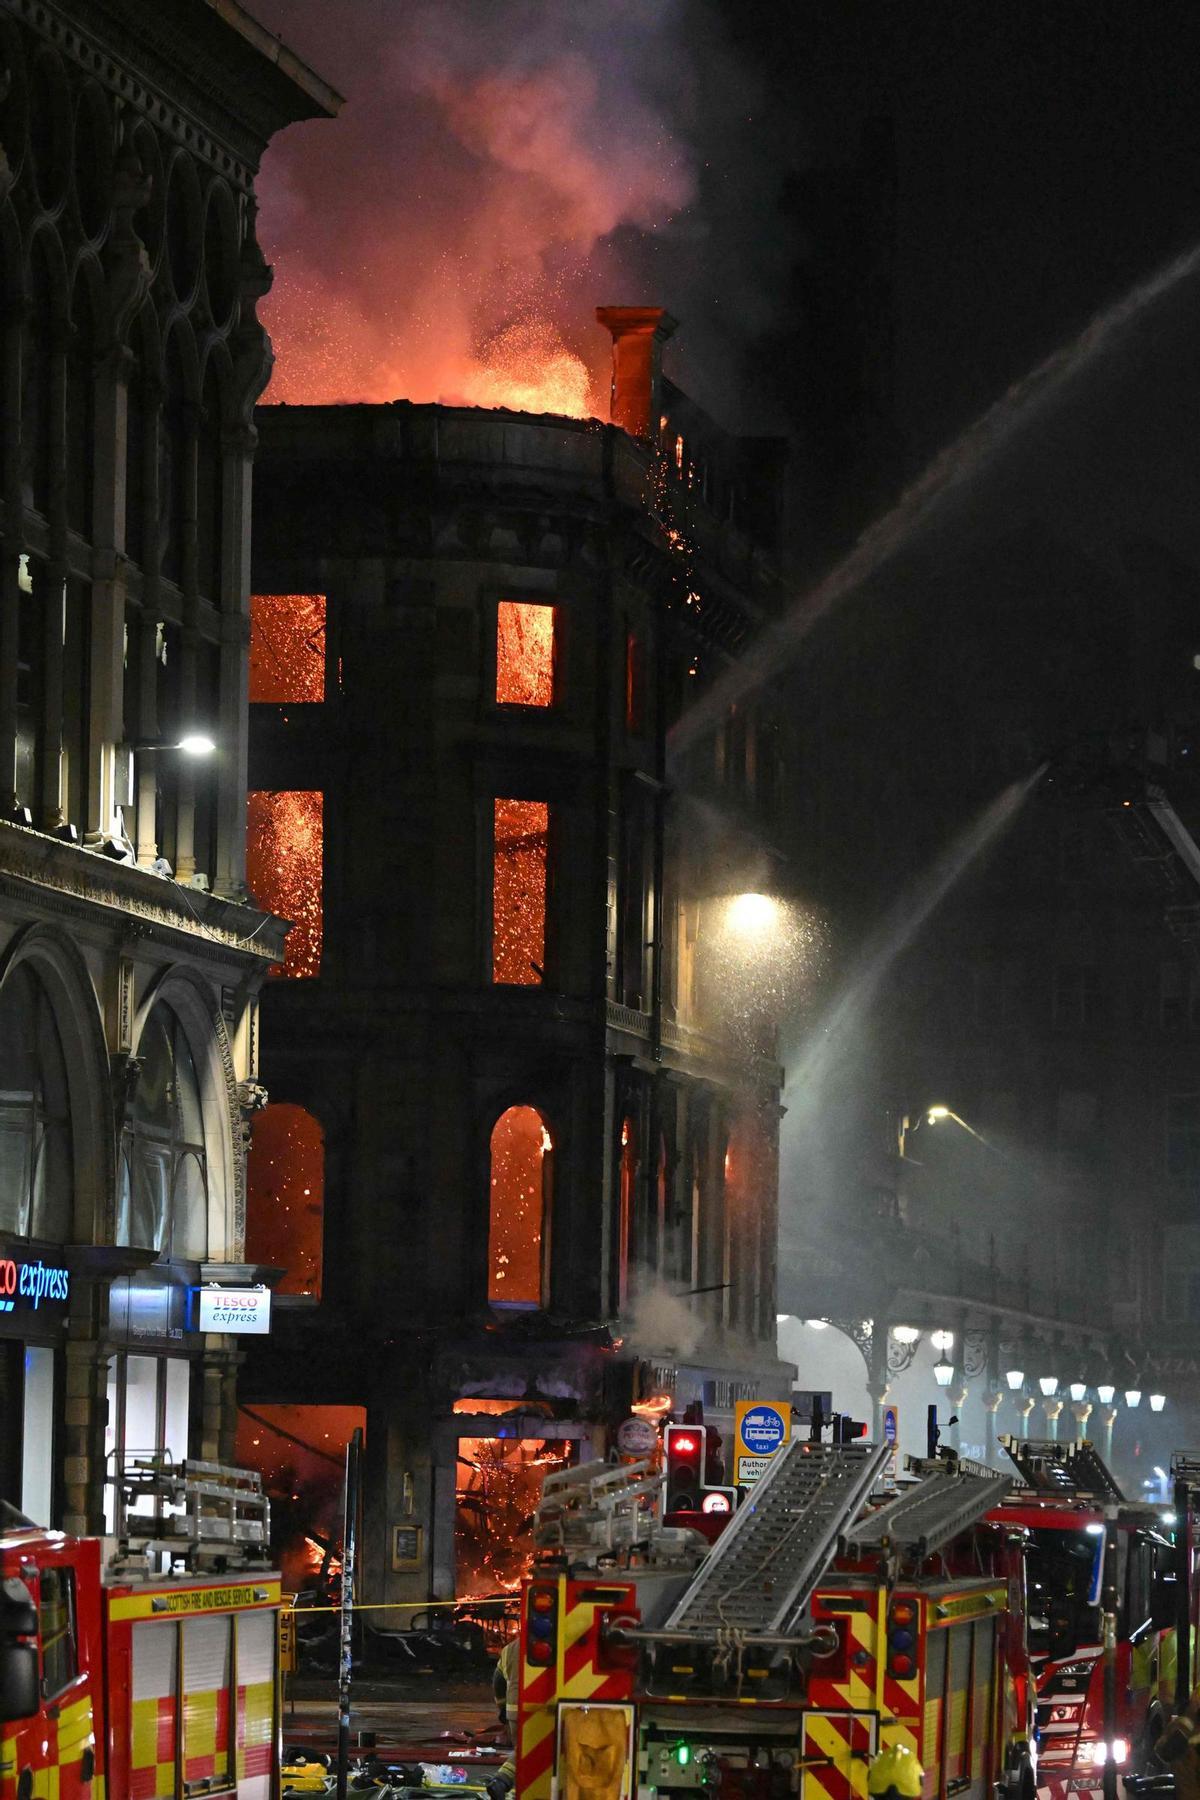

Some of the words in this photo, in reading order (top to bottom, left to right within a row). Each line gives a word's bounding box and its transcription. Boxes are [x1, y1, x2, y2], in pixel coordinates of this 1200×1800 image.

[20, 1260, 69, 1310] express
[213, 1295, 258, 1308] TESCO
[212, 1312, 258, 1324] express
[742, 1460, 768, 1468] Author
[167, 1594, 190, 1612] SCOTTISH
[191, 1592, 202, 1610] FIRE
[203, 1590, 213, 1608] AND
[214, 1588, 231, 1607] RESCUE
[232, 1587, 251, 1606] SERVICE
